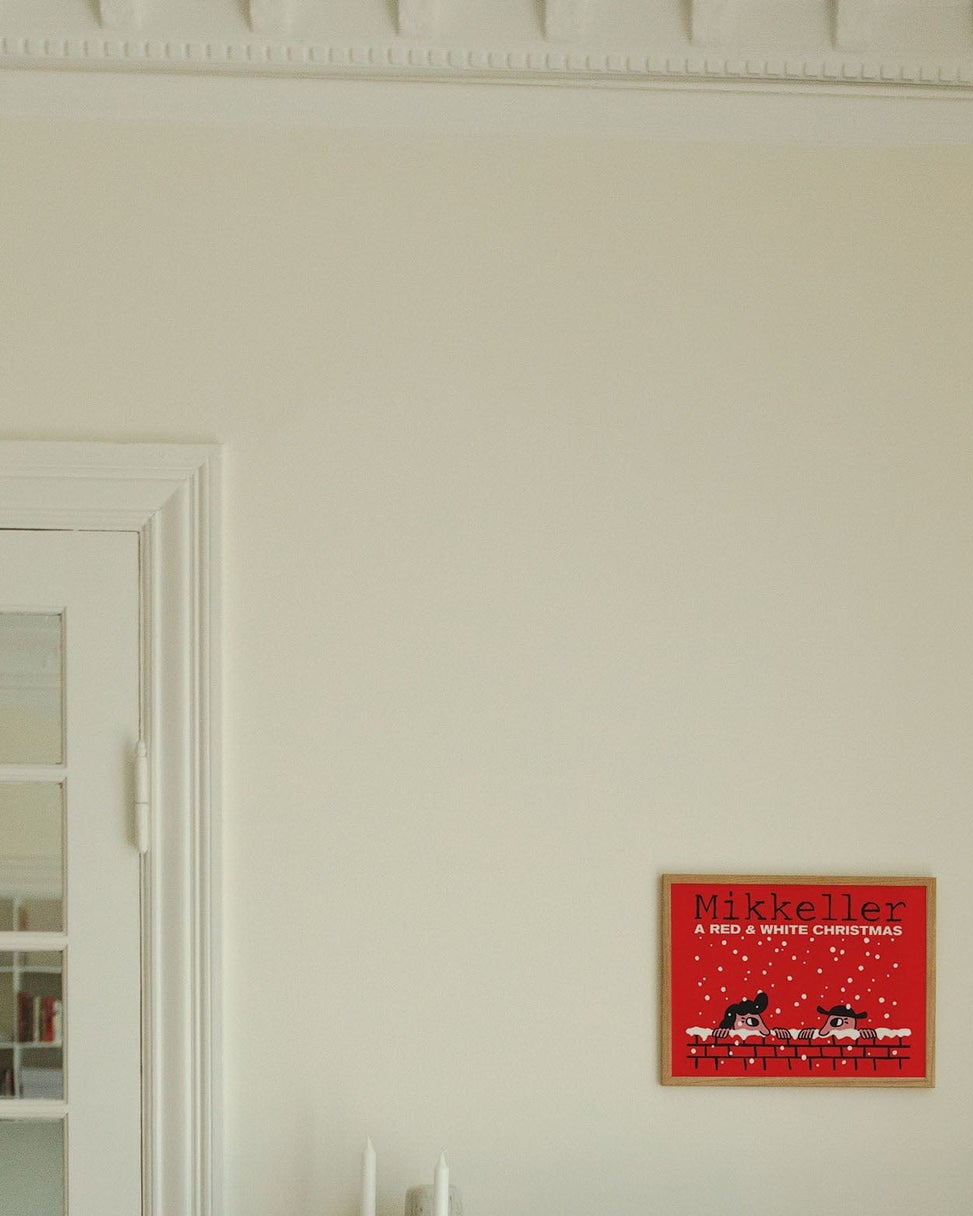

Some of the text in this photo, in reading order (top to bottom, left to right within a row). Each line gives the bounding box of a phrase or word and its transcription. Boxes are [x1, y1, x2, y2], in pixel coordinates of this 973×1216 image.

[694, 891, 906, 922] Mikkeller
[694, 924, 903, 936] A RED & WHITE CHRISTMAS
